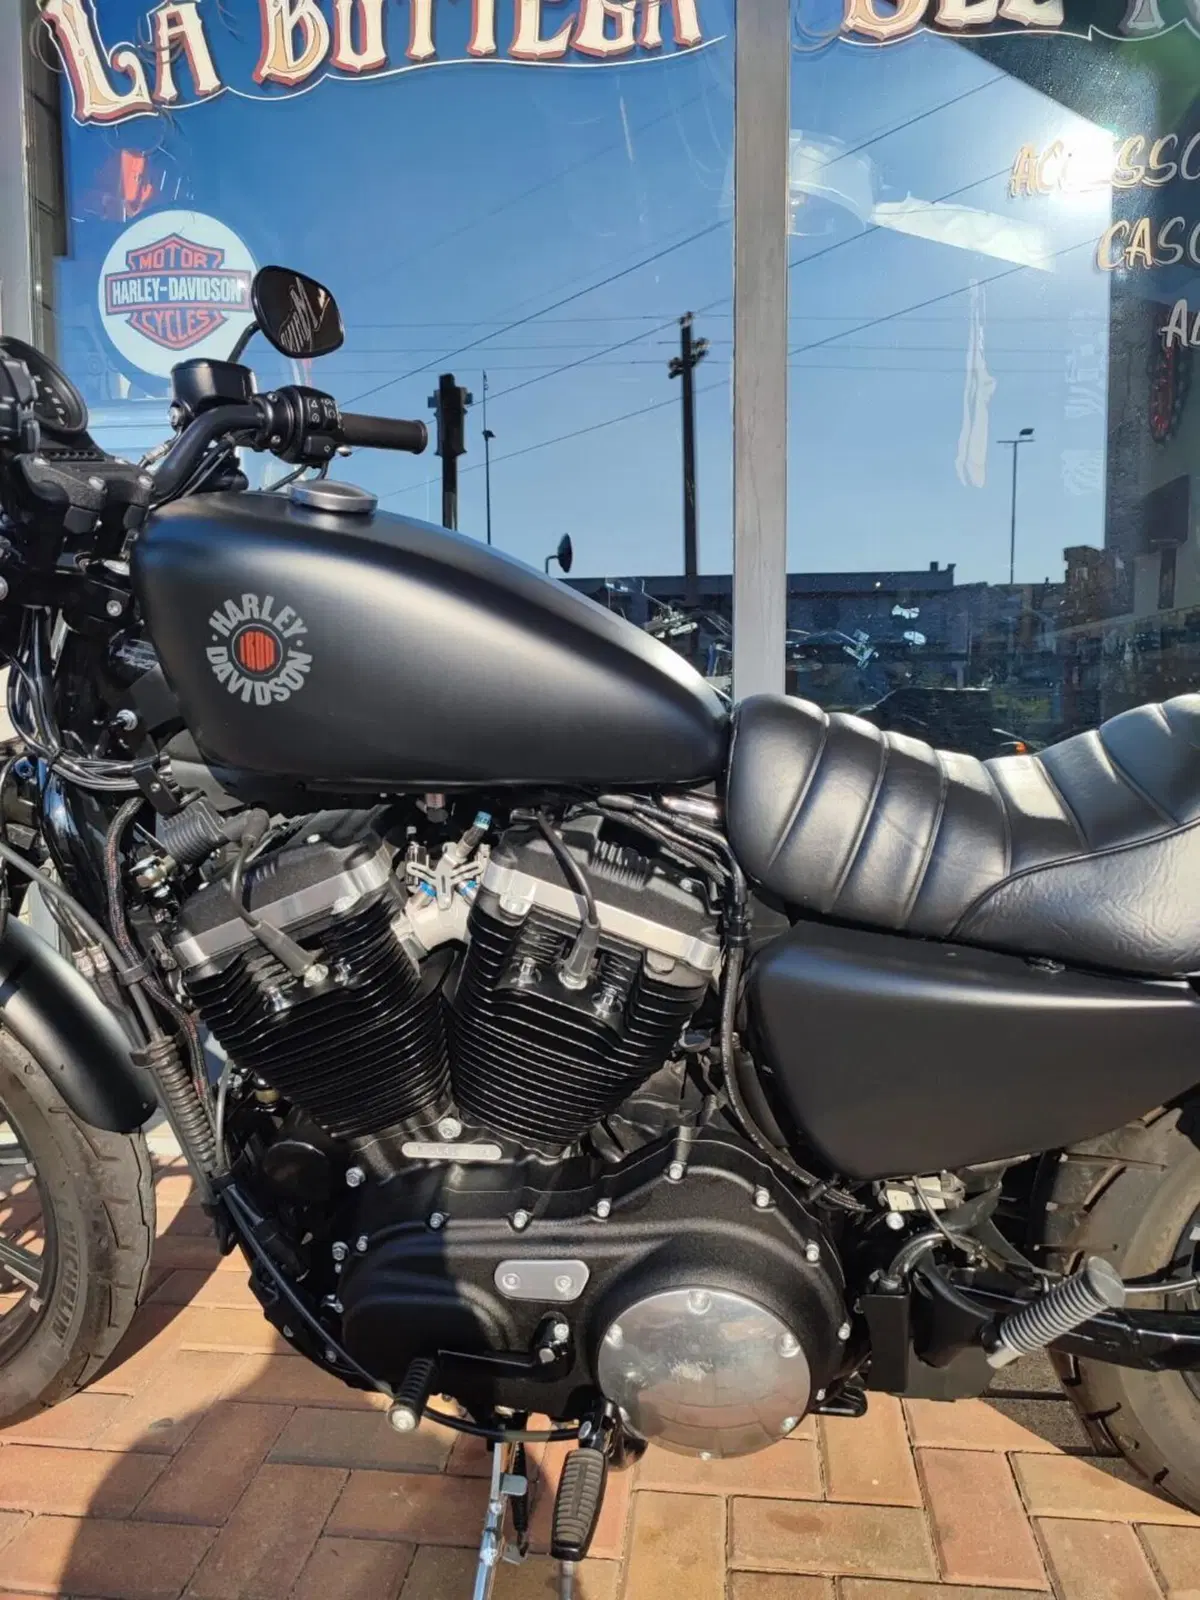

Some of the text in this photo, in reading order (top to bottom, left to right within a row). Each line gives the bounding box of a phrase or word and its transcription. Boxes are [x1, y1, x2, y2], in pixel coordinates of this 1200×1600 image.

[41, 0, 220, 120] LA
[1008, 132, 1200, 198] ACSSO
[139, 241, 209, 270] MOTOR
[112, 276, 243, 306] HARLEY-DAVIDSON
[141, 309, 211, 342] CYCLES
[208, 593, 308, 638] HARLEY
[206, 646, 313, 706] DAVIDSON
